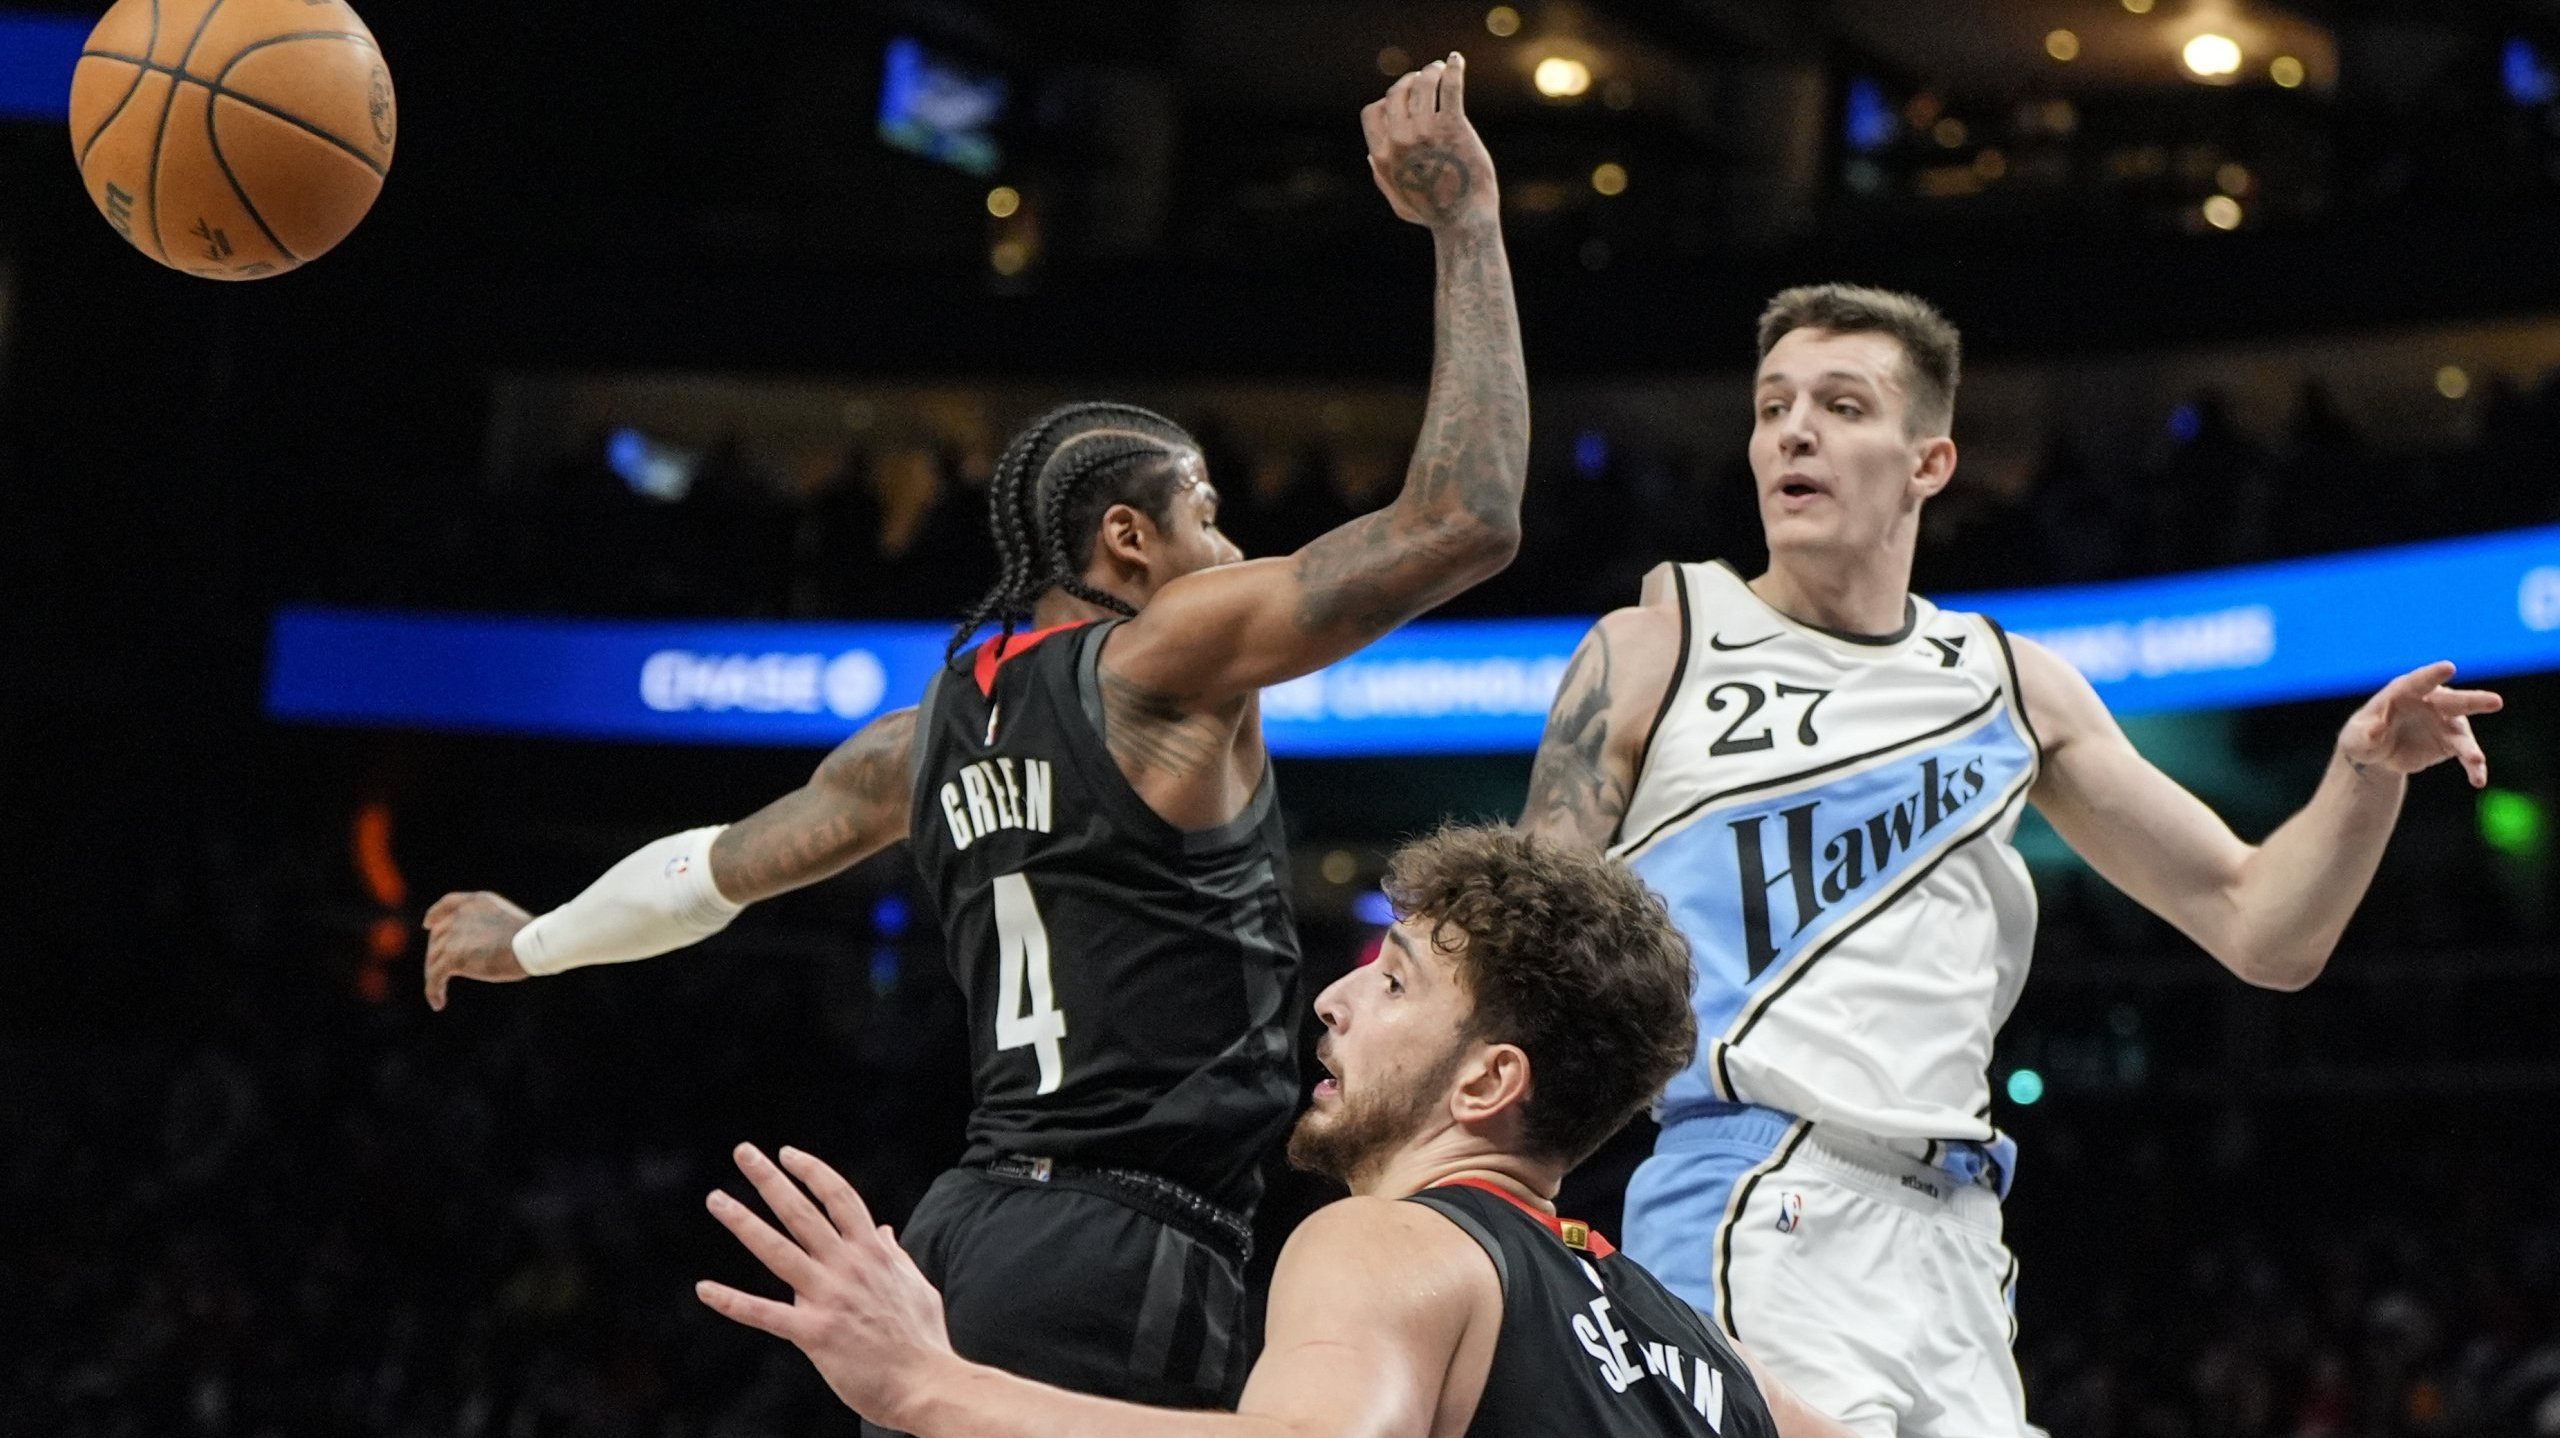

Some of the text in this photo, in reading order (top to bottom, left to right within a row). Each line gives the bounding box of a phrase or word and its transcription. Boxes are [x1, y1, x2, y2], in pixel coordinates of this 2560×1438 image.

[1706, 681, 1833, 757] 27
[940, 757, 1051, 851] GREEN
[1727, 754, 1986, 986] Hawks
[993, 872, 1067, 1095] 4
